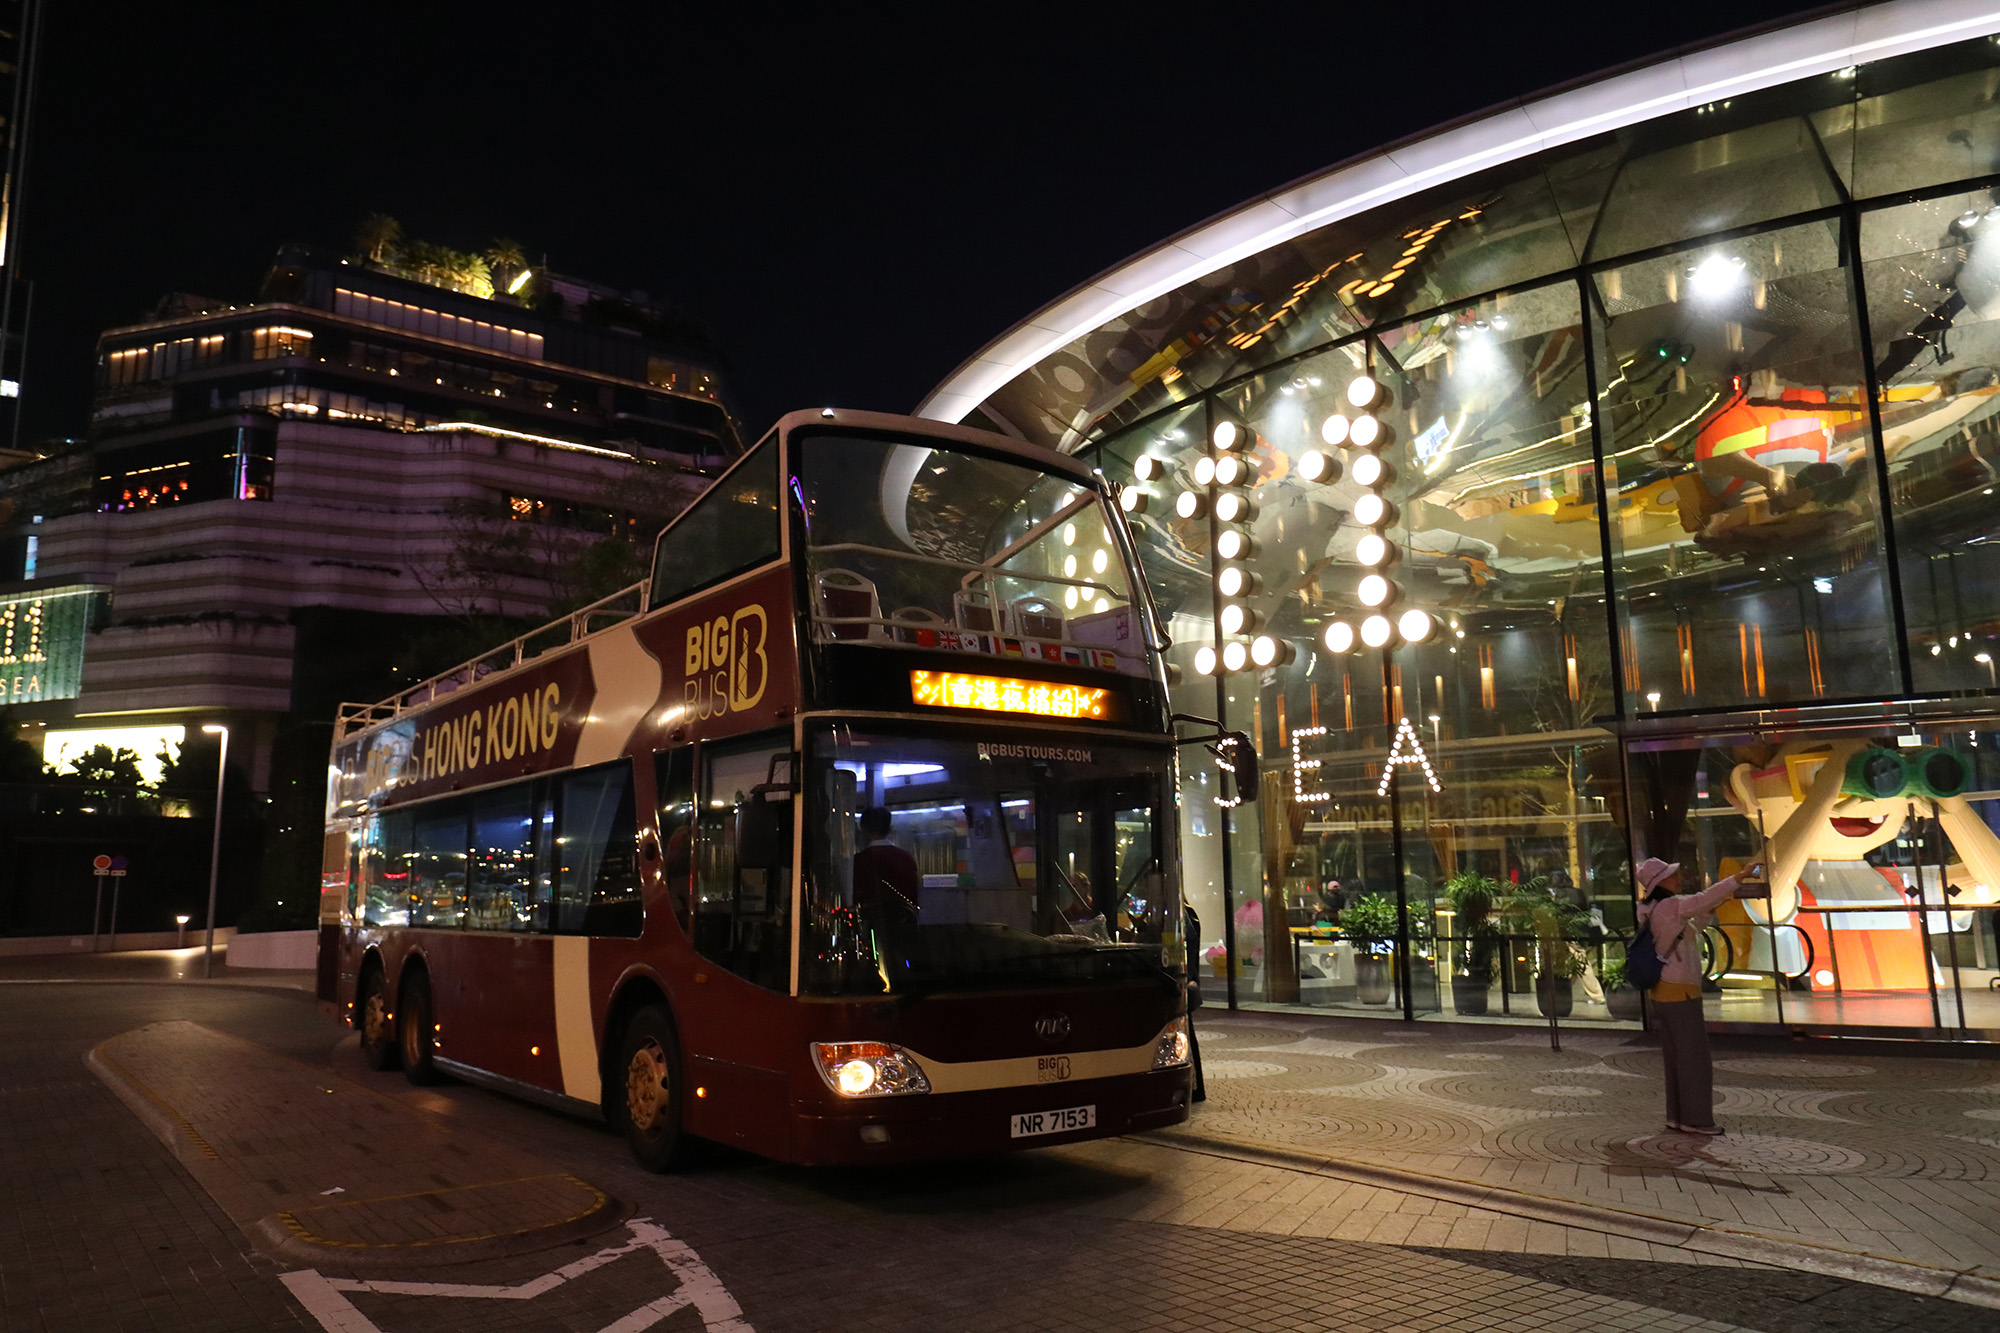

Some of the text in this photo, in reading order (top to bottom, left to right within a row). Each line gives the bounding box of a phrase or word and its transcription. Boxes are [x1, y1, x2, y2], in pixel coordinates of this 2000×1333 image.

[685, 615, 729, 677] BIG
[684, 671, 728, 724] BUS
[423, 709, 481, 781] HONG
[485, 682, 560, 765] KONG
[977, 742, 1092, 763] BIGBUSTOURS.COM
[1038, 1057, 1056, 1070] BIG
[1020, 1108, 1088, 1134] NR 7153
